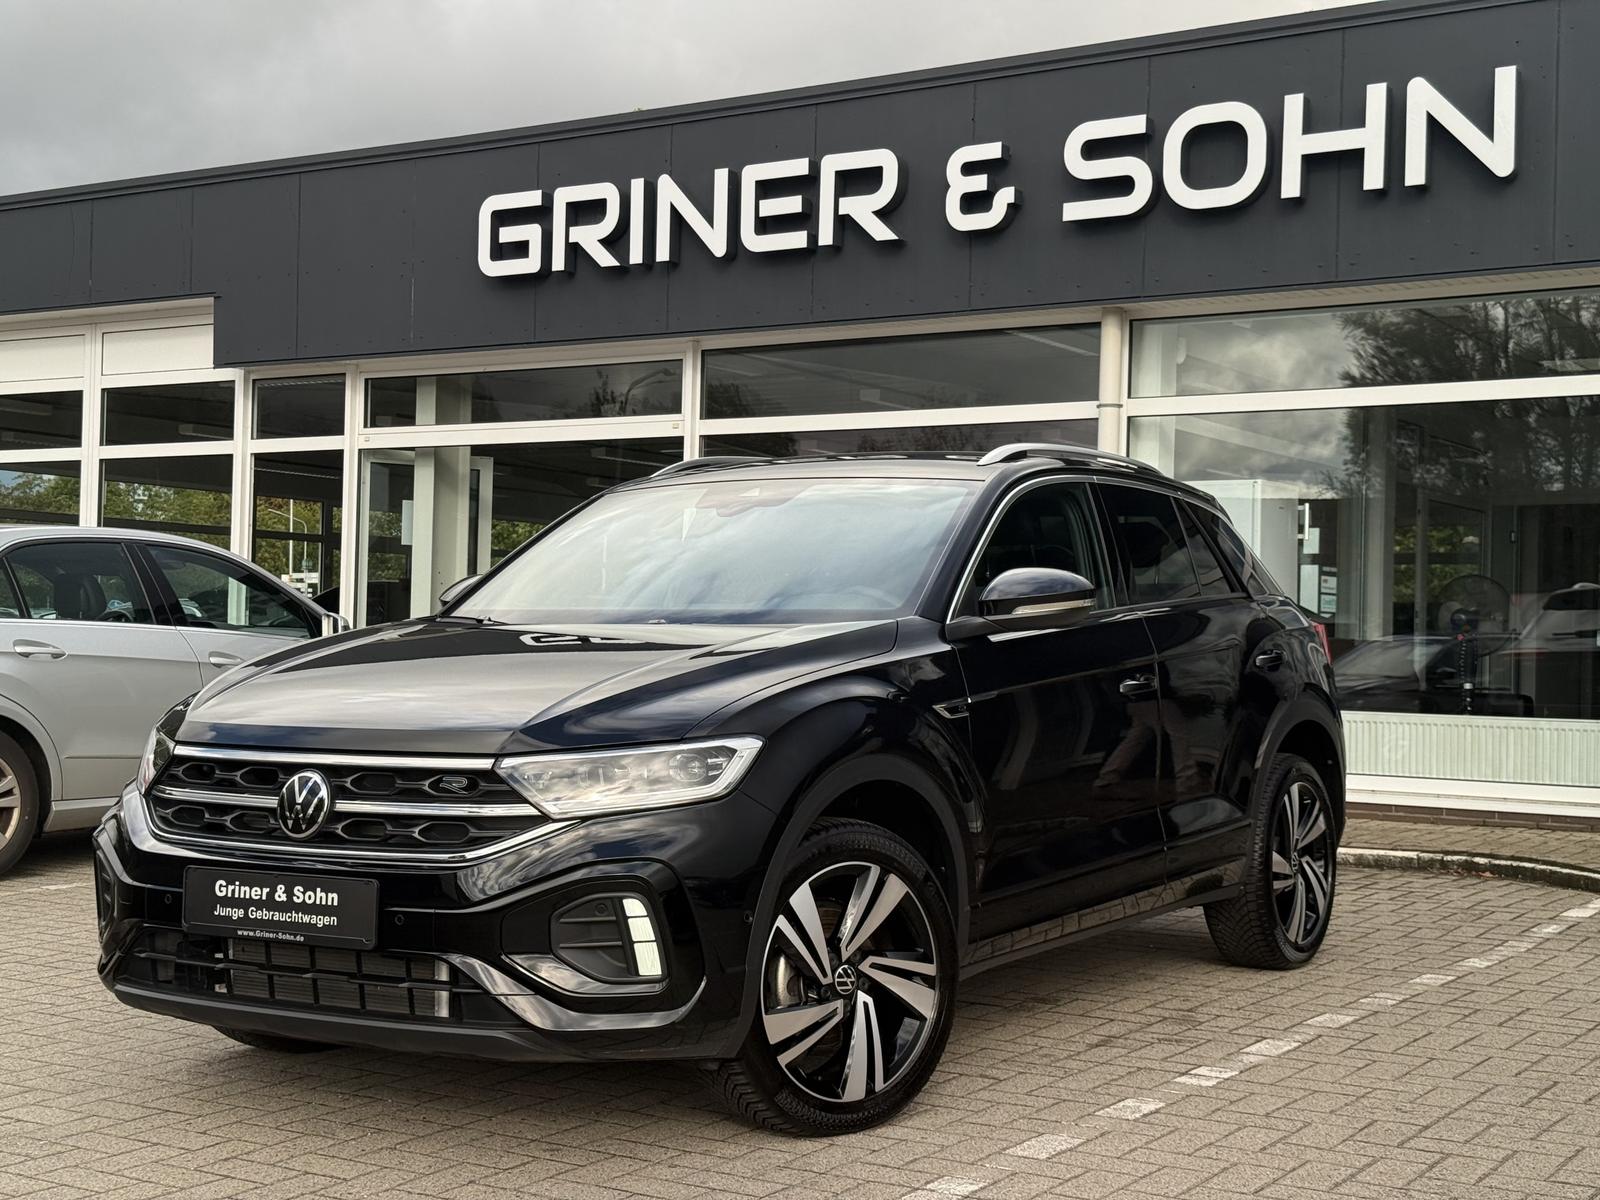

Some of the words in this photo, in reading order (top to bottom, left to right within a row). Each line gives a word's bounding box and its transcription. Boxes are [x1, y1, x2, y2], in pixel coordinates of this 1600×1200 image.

[478, 149, 899, 277] GRINER
[946, 142, 1015, 232] &
[1062, 65, 1517, 222] SOHN
[214, 879, 270, 901] Griner
[274, 884, 288, 903] &
[292, 885, 339, 906] Sohn
[214, 904, 245, 920] Junge
[248, 907, 338, 928] Gebrauchtwagen
[236, 929, 305, 942] www.Griner-Sohn.de
